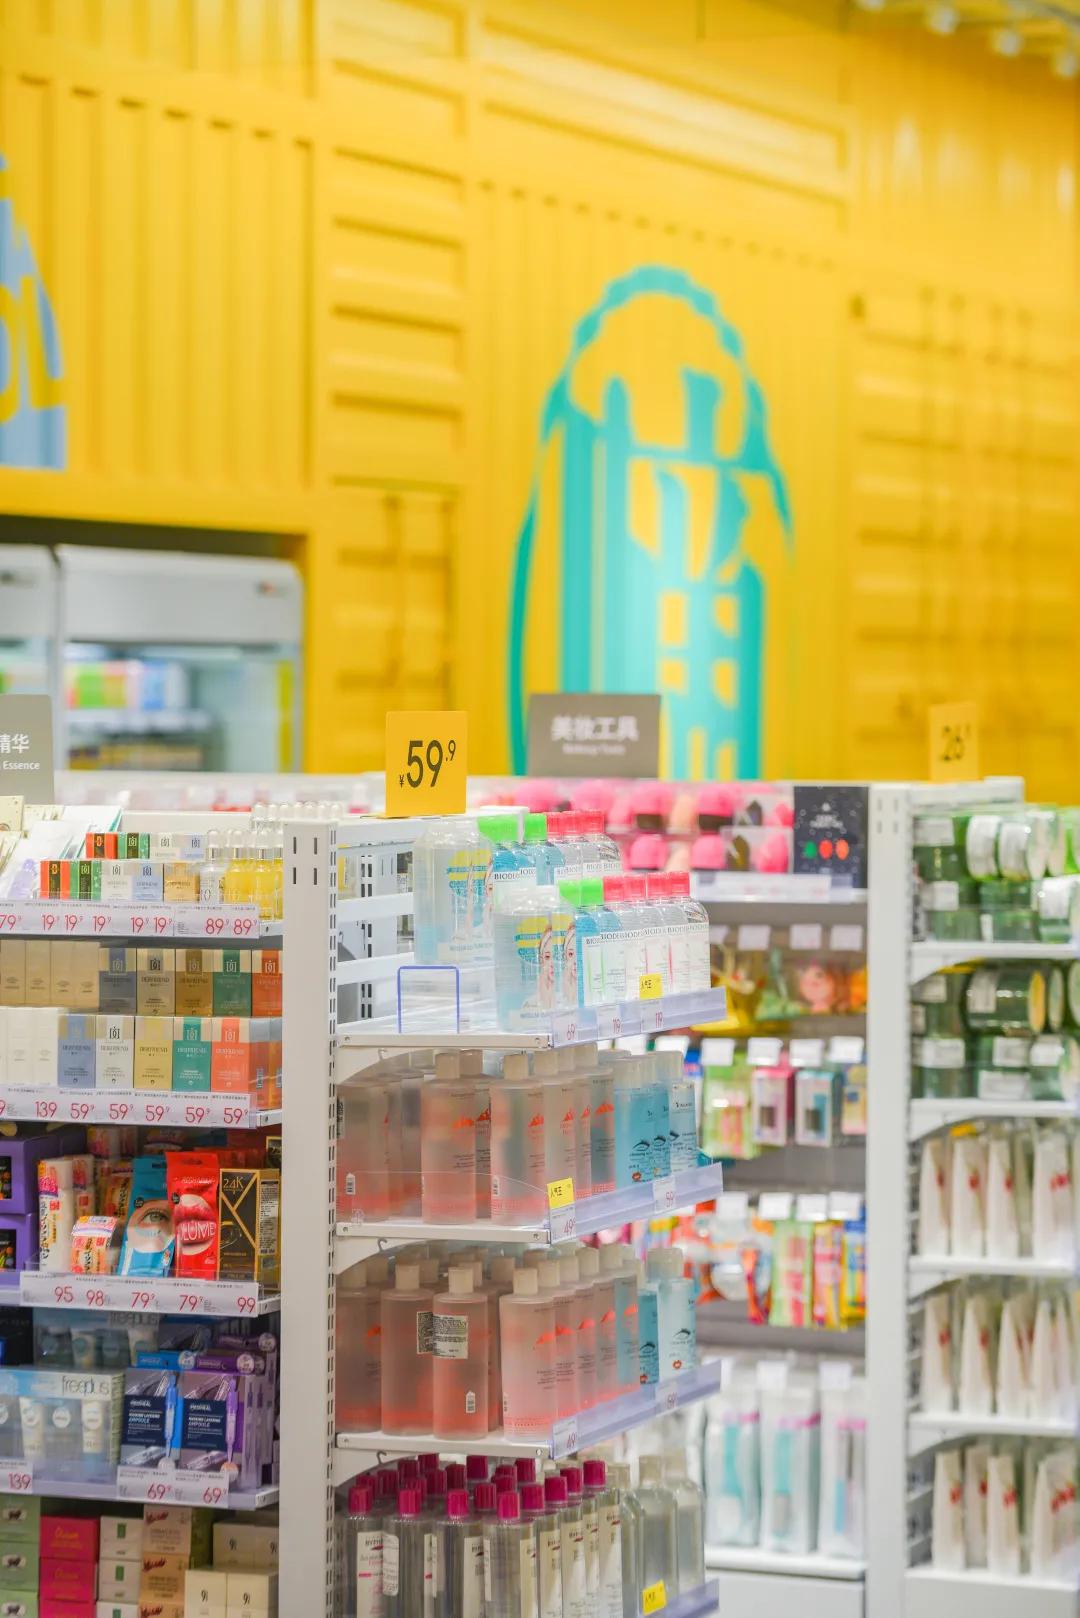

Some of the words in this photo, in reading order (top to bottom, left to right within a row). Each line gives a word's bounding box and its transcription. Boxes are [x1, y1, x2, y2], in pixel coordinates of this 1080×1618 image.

[3, 761, 40, 770] Essence
[35, 1101, 57, 1118] 139
[54, 1286, 74, 1303] 95
[86, 1289, 104, 1307] 98
[237, 1297, 256, 1313] 99
